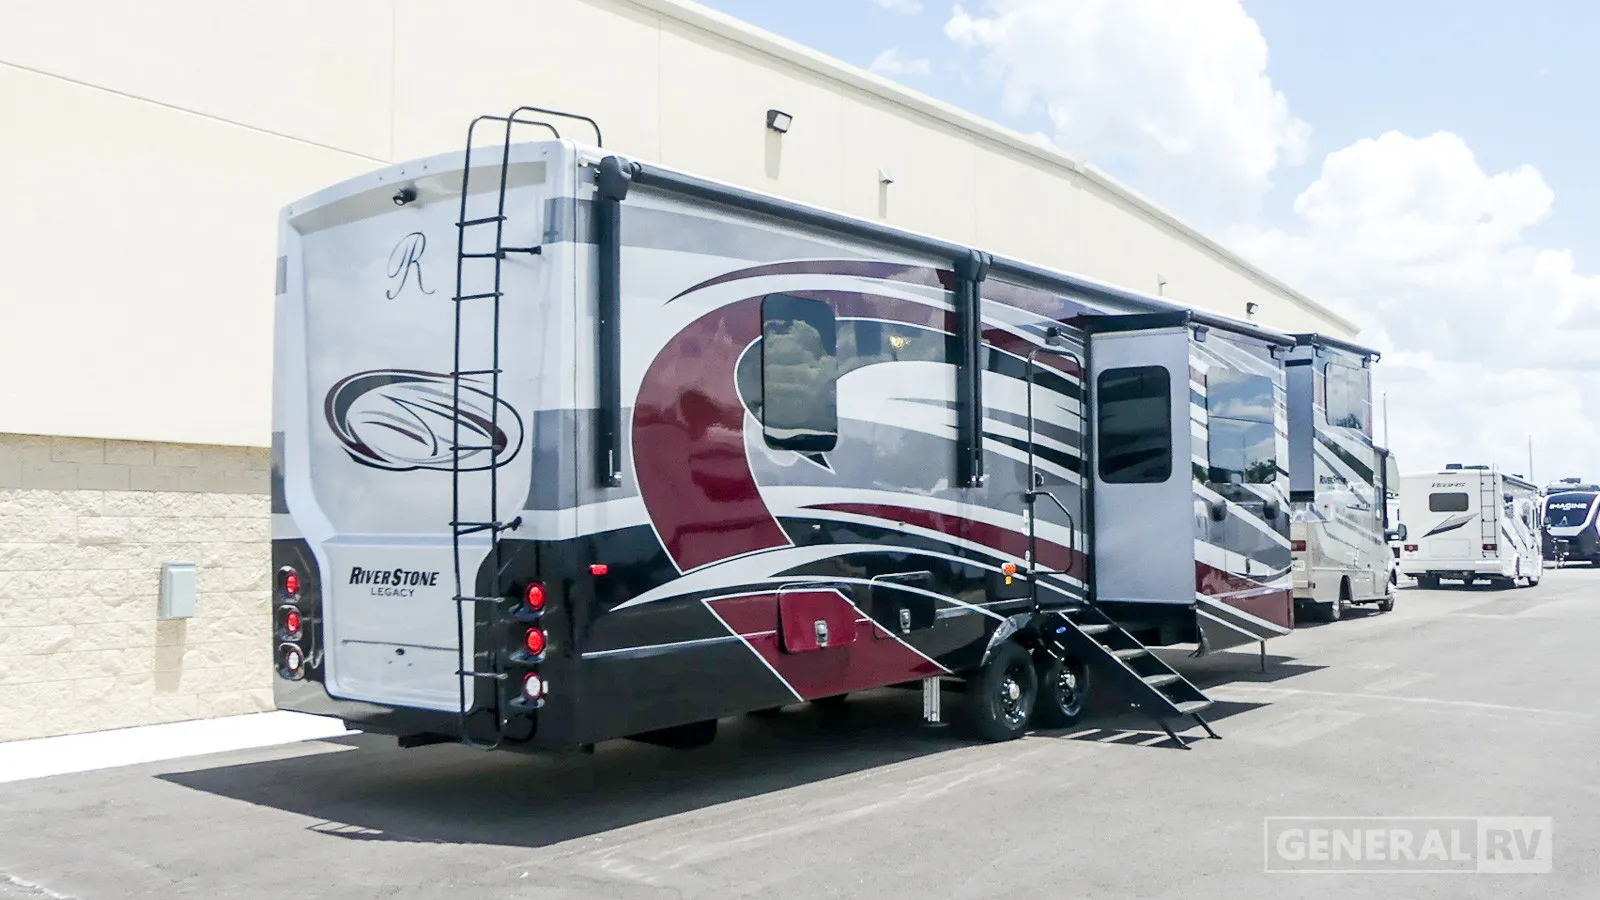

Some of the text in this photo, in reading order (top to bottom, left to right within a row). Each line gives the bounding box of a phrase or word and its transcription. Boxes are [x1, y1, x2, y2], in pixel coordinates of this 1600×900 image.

[1549, 502, 1588, 510] IMAGINE
[349, 566, 440, 587] RIVERSTONE
[370, 587, 415, 598] LEGACY
